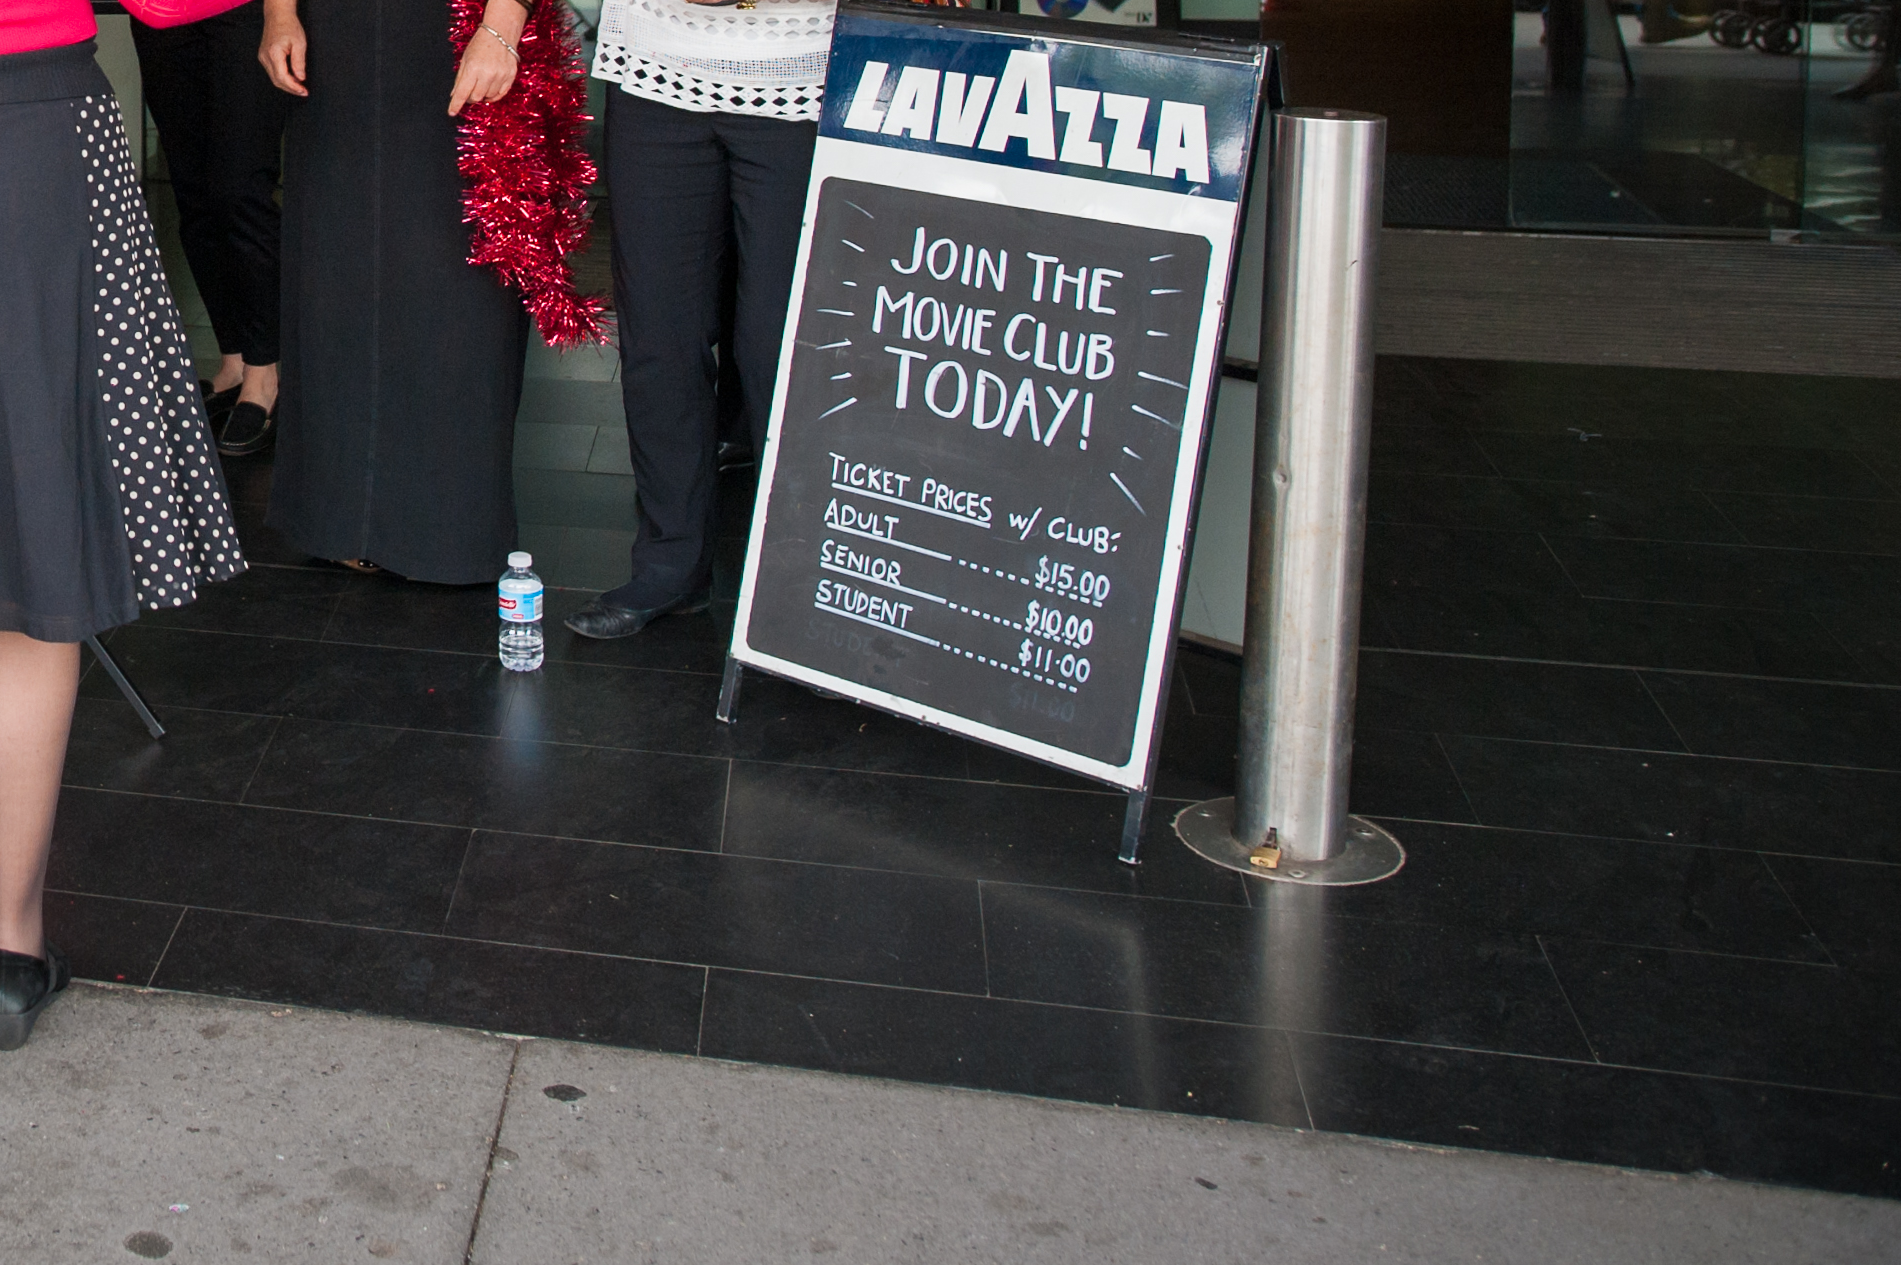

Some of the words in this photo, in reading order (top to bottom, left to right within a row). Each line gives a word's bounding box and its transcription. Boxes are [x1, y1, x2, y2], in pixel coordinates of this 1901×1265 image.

[843, 49, 1210, 184] LAVAZZA
[890, 226, 1008, 292] JOIN
[1026, 251, 1124, 315] THE
[872, 285, 997, 356] MOVIE
[1003, 313, 1115, 380] CLUB
[884, 345, 1094, 450] TODAY!
[828, 451, 911, 498] TICKET
[921, 477, 993, 523] PRICES
[819, 538, 902, 586] SENIOR
[1024, 599, 1095, 647] $10.00
[823, 497, 900, 541] ADULT
[1034, 554, 1112, 602] $15.00
[814, 578, 914, 629] STUDENT
[1017, 637, 1092, 684] $11.00
